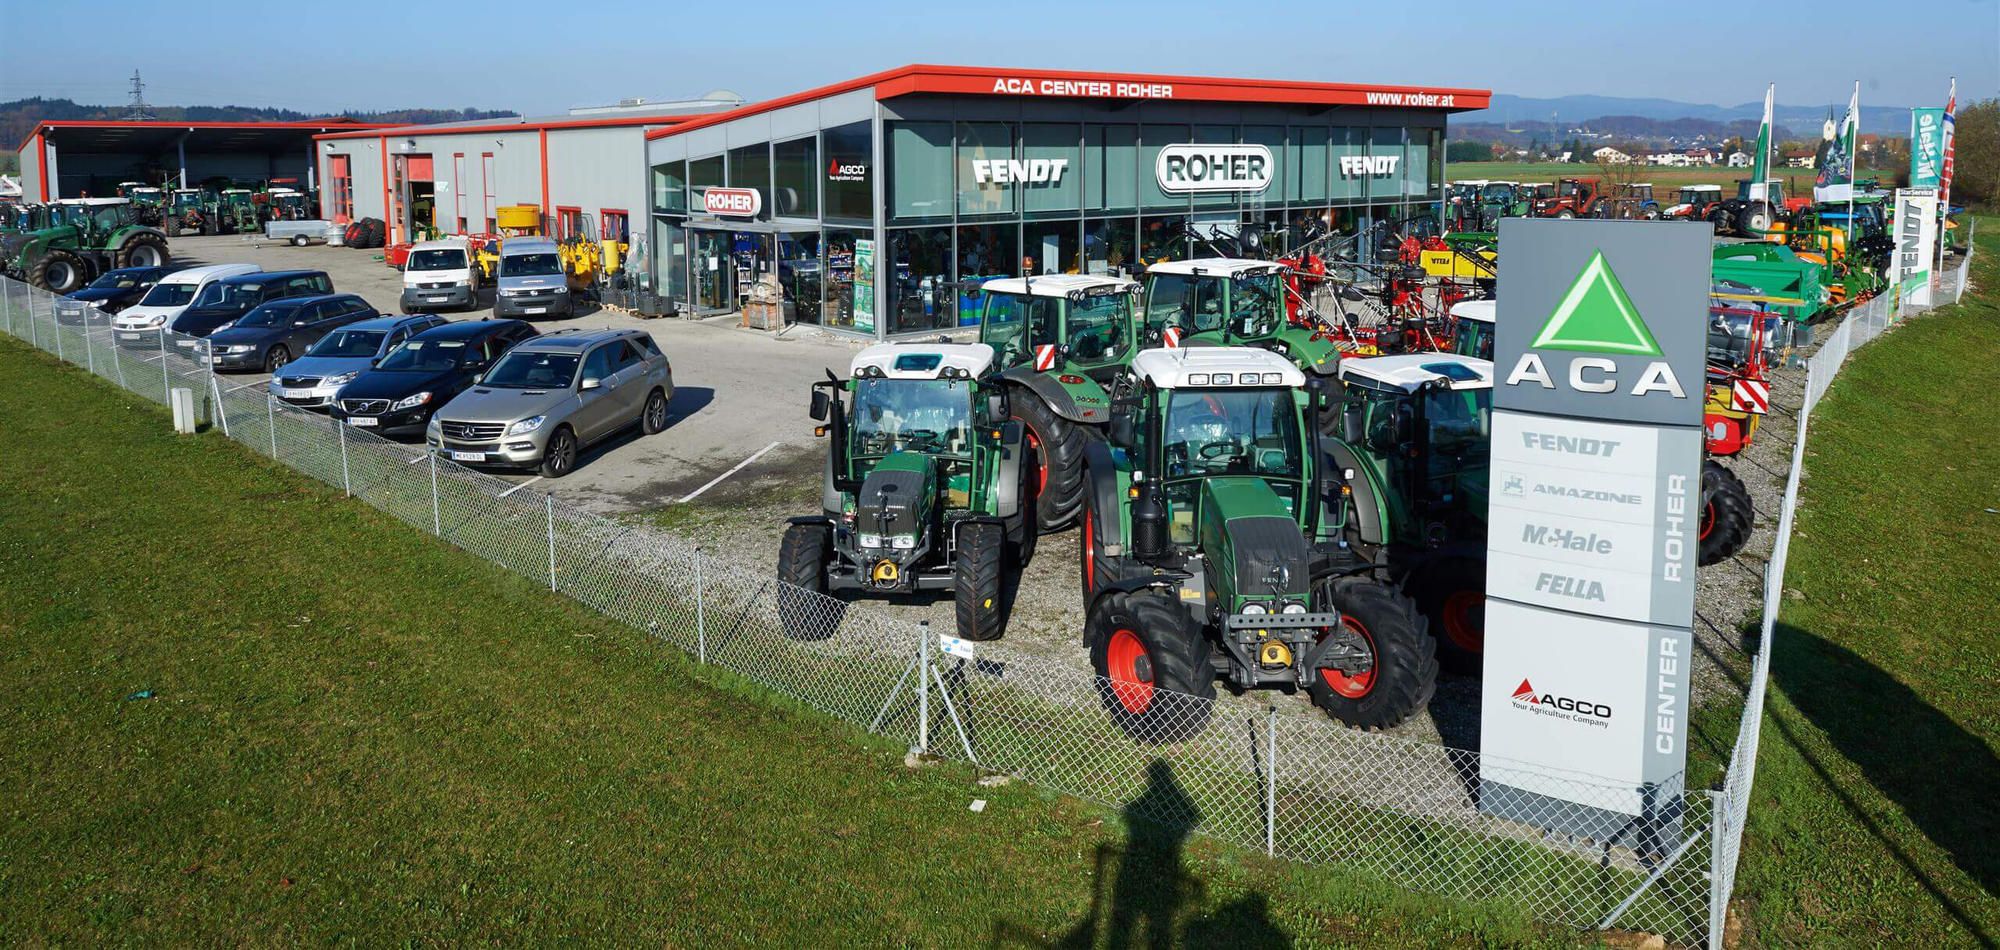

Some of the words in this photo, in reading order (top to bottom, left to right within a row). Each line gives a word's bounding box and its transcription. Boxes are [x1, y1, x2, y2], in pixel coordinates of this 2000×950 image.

[993, 79, 1035, 94] ACA
[1040, 80, 1111, 96] CENTER
[1116, 83, 1172, 98] ROHER
[1366, 91, 1455, 107] www.roher.at
[840, 165, 865, 175] AGCO
[972, 159, 1068, 183] FENDT
[1166, 154, 1265, 182] ROHER
[1340, 155, 1400, 175] FENDT
[707, 193, 752, 210] ROHER
[1900, 200, 1921, 280] FENDT
[1506, 353, 1687, 399] ACA
[1522, 431, 1621, 457] FENDT
[1533, 483, 1642, 504] AMAZONE
[1522, 523, 1613, 554] McHale
[1664, 474, 1686, 582] ROHER
[1535, 572, 1605, 602] FELLA
[1540, 694, 1612, 718] AGCO
[1656, 637, 1678, 754] CENTER
[1511, 701, 1528, 712] Your
[1529, 705, 1571, 721] Agriculture
[1573, 714, 1609, 729] Company
